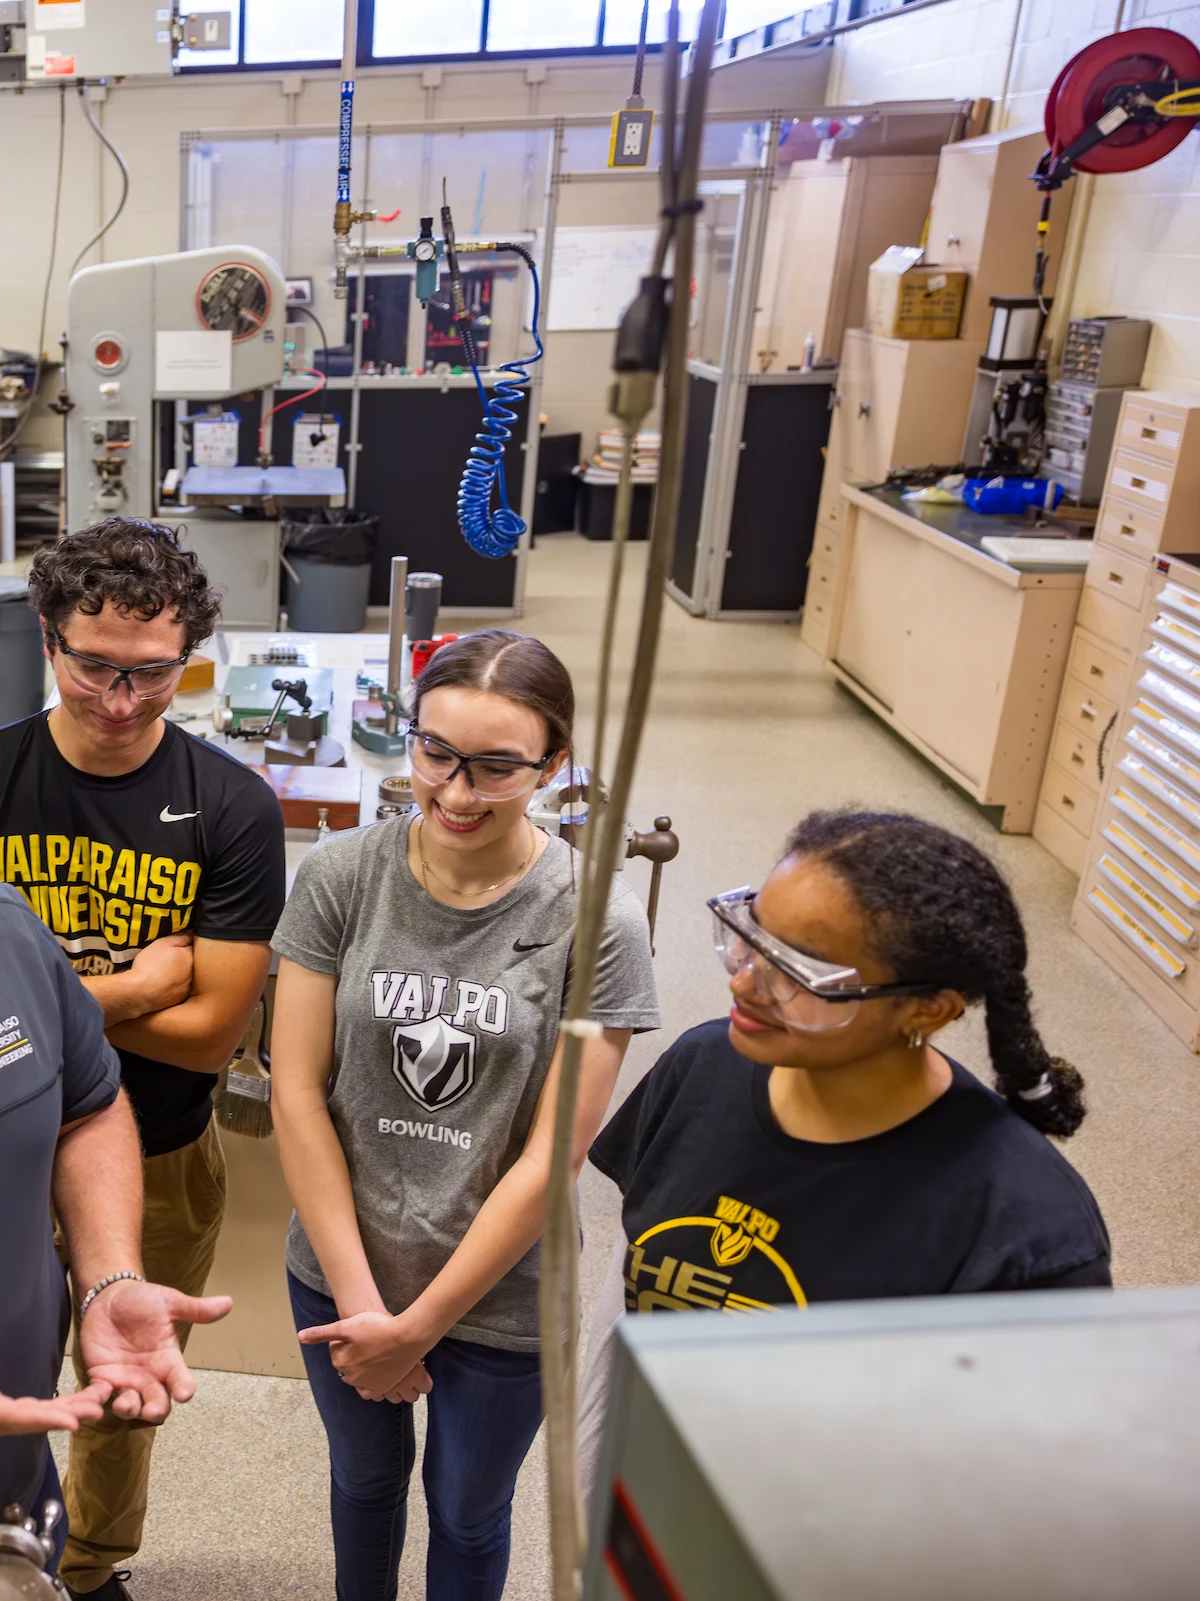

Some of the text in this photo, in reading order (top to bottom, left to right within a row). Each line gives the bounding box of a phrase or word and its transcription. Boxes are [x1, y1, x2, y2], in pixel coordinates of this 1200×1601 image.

[338, 173, 350, 191] AIR
[16, 885, 193, 947] NIVERSITY
[371, 971, 509, 1036] VALPO
[378, 1117, 472, 1150] BOWLING
[714, 1195, 781, 1243] VALPO
